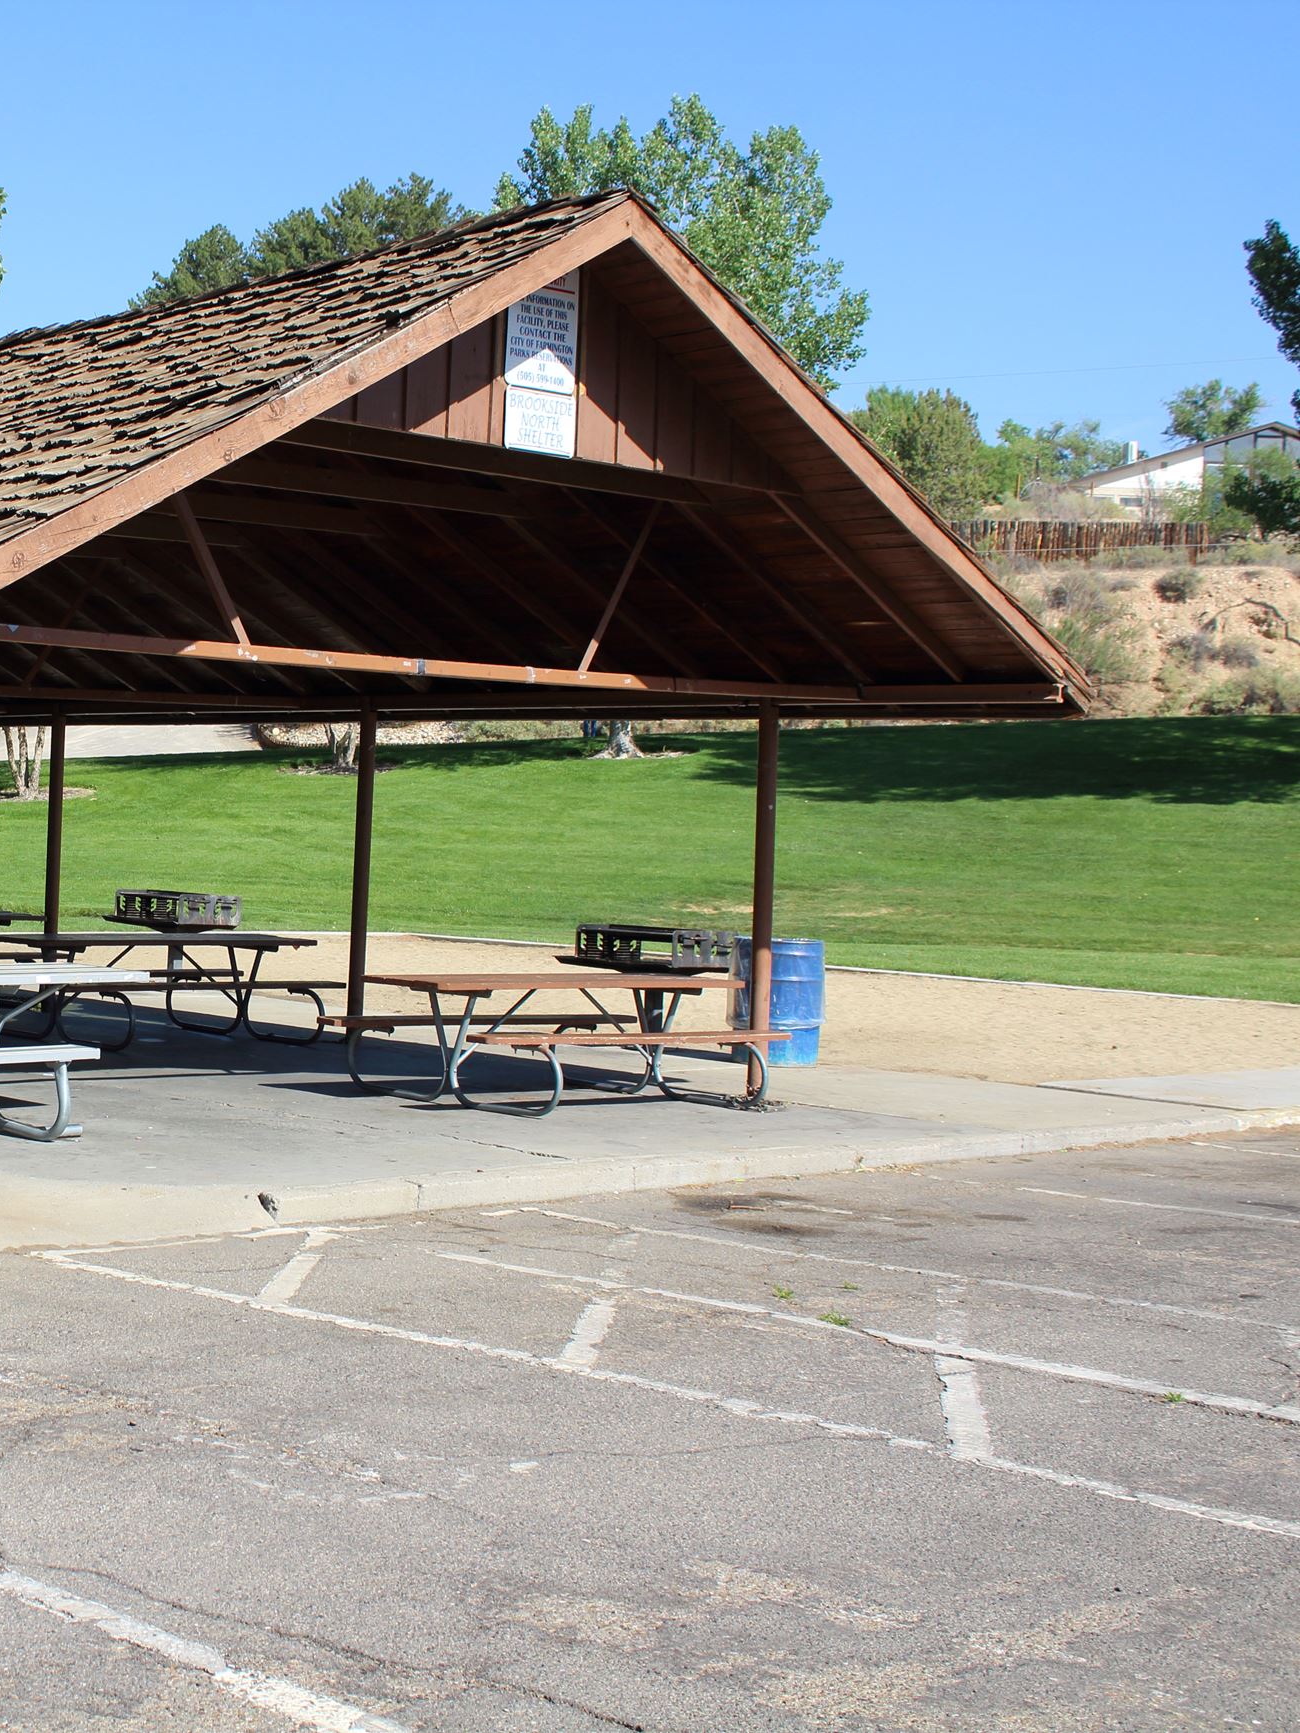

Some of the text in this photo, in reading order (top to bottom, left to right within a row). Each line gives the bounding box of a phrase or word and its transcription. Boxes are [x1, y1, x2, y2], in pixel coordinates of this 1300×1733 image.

[520, 304, 567, 320] THE USE OF THIS
[566, 301, 575, 311] ON
[517, 314, 570, 332] FACILITY, PLEASE
[519, 326, 566, 343] CONTACT THE
[509, 347, 530, 358] PARKS
[510, 336, 573, 355] CITY OF FARMINGTON
[538, 363, 546, 372] AT
[509, 393, 573, 417] BROOKSIDE
[520, 411, 560, 432] NORTH
[517, 428, 564, 448] SHELTER
